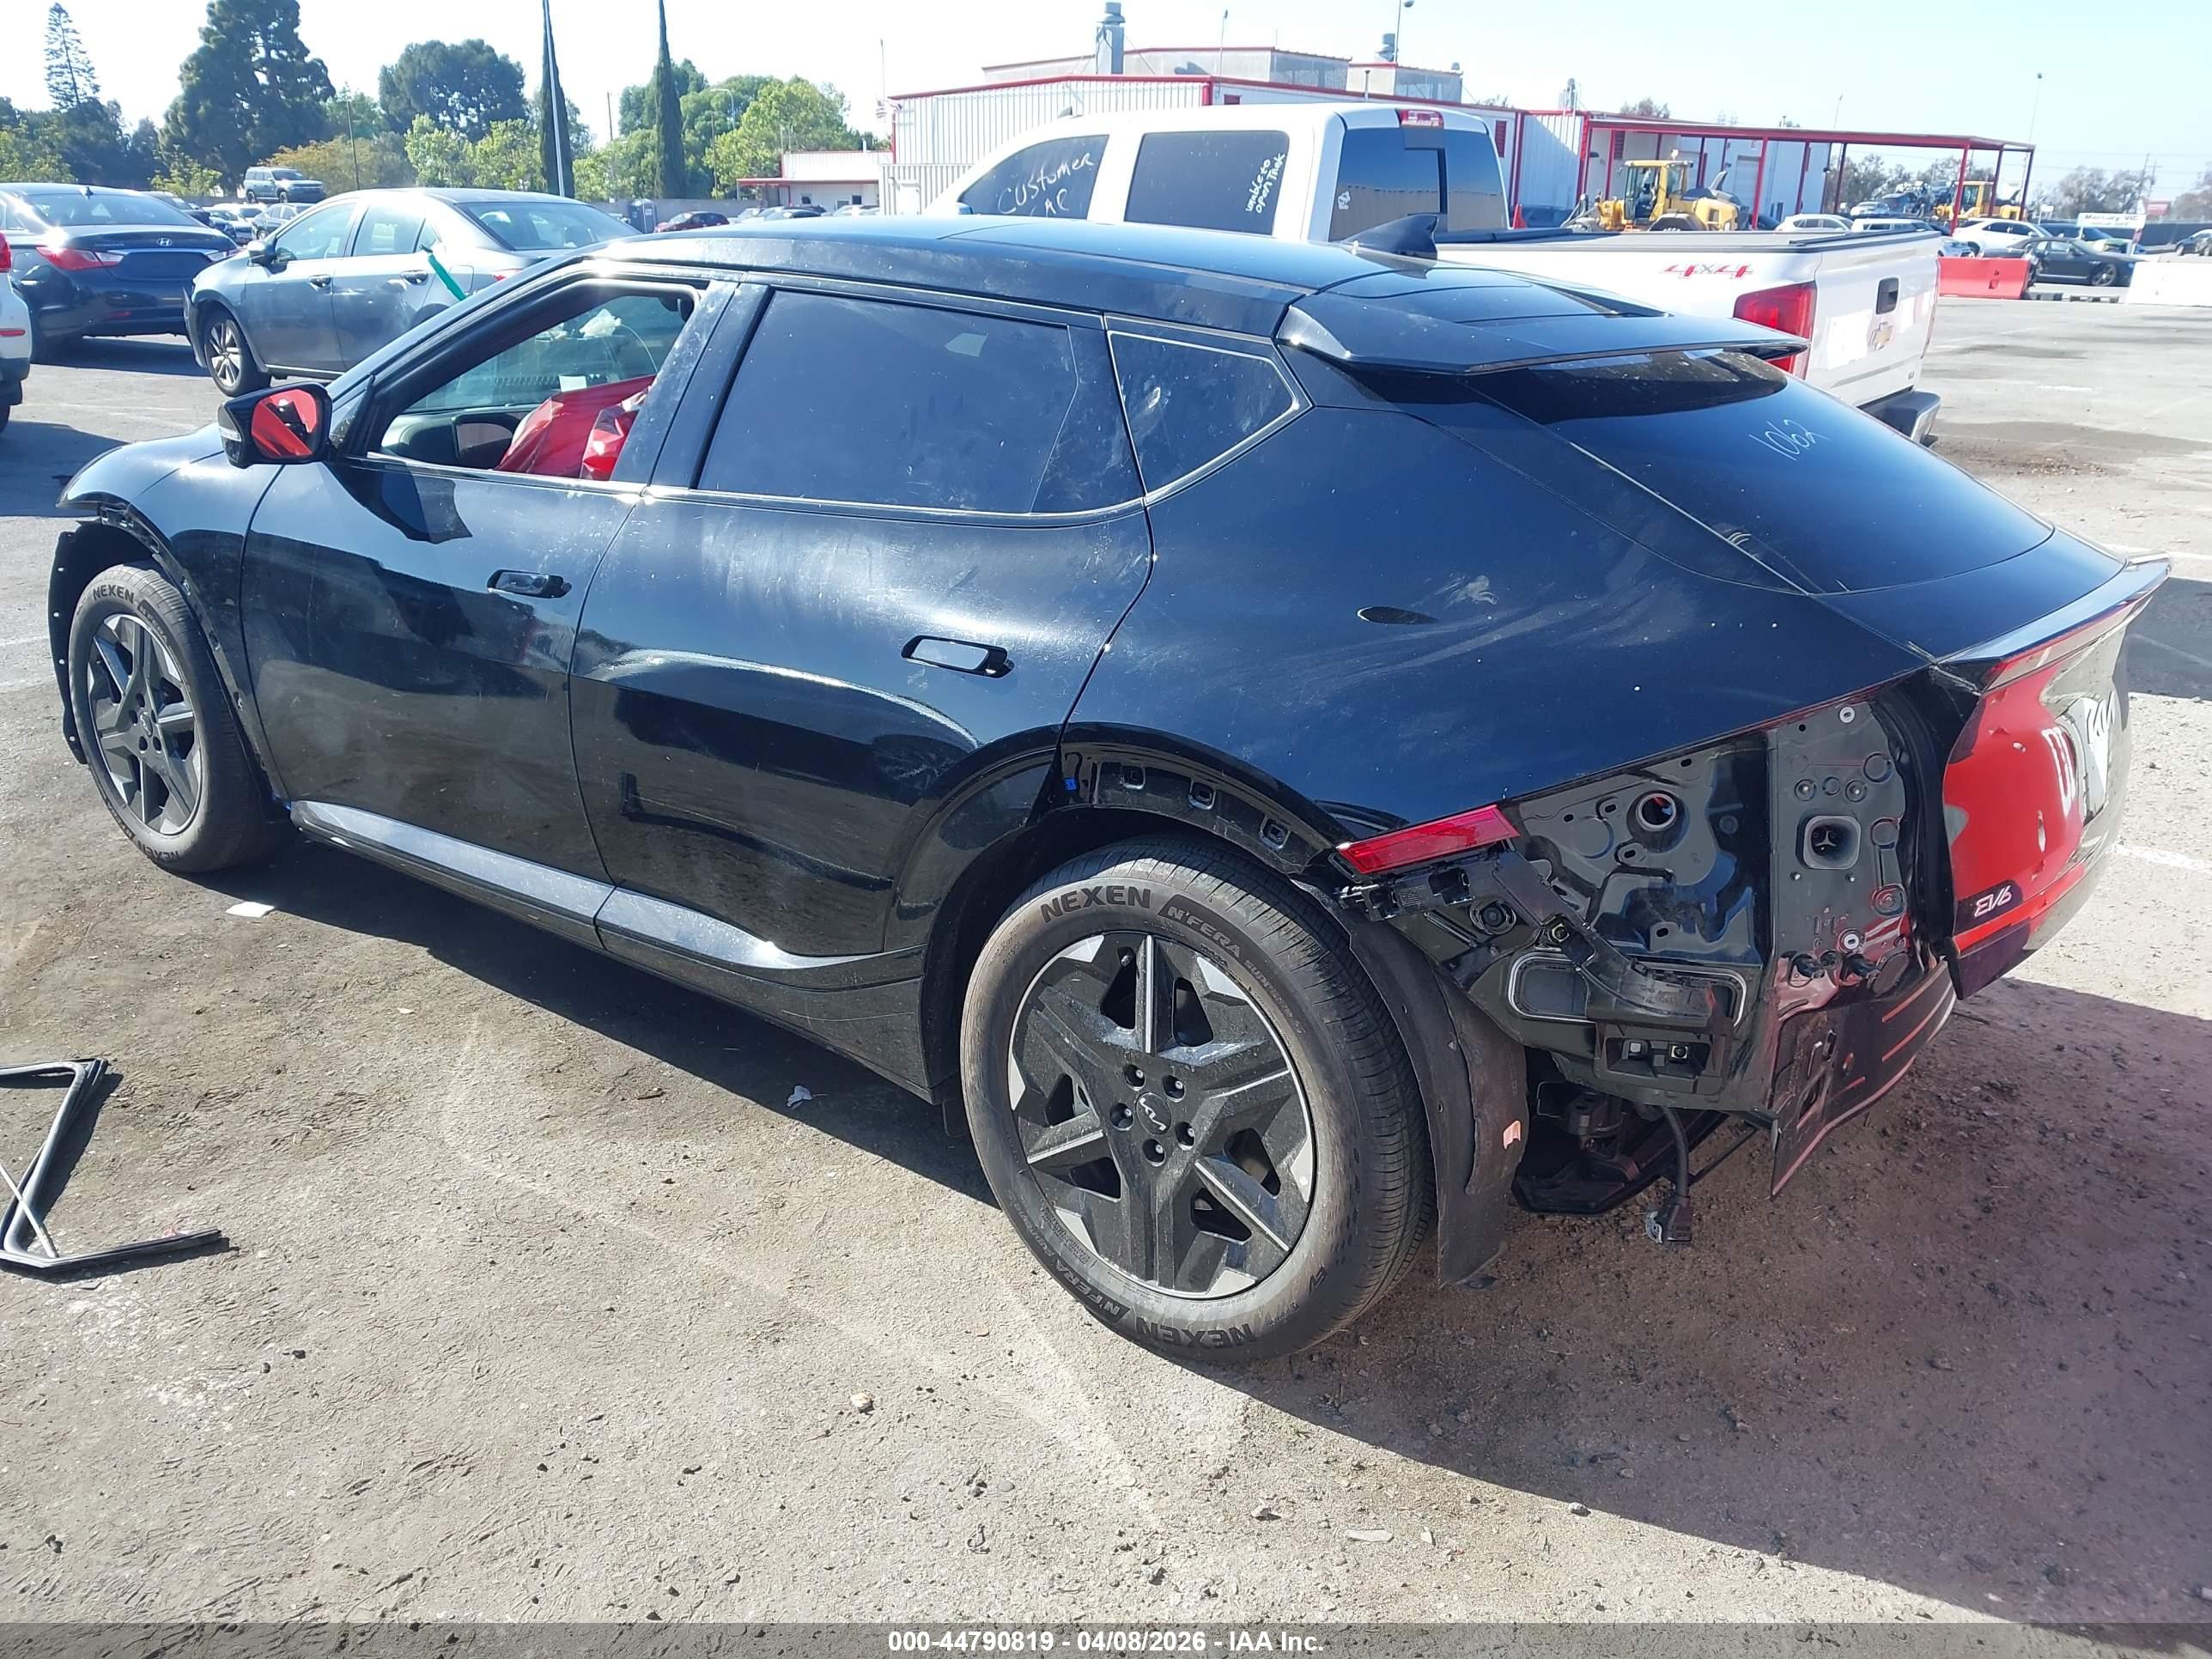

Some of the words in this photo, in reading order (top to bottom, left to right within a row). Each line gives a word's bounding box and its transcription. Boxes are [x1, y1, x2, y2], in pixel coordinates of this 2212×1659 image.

[1748, 419, 1832, 460] 1062
[93, 584, 135, 605] NEXEN
[1974, 885, 2013, 918] EV6
[1040, 885, 1152, 923] NEXEN
[1167, 906, 1241, 958] N'FERA
[1055, 1259, 1121, 1317] N'FERA
[1136, 1317, 1257, 1349] NEXEN
